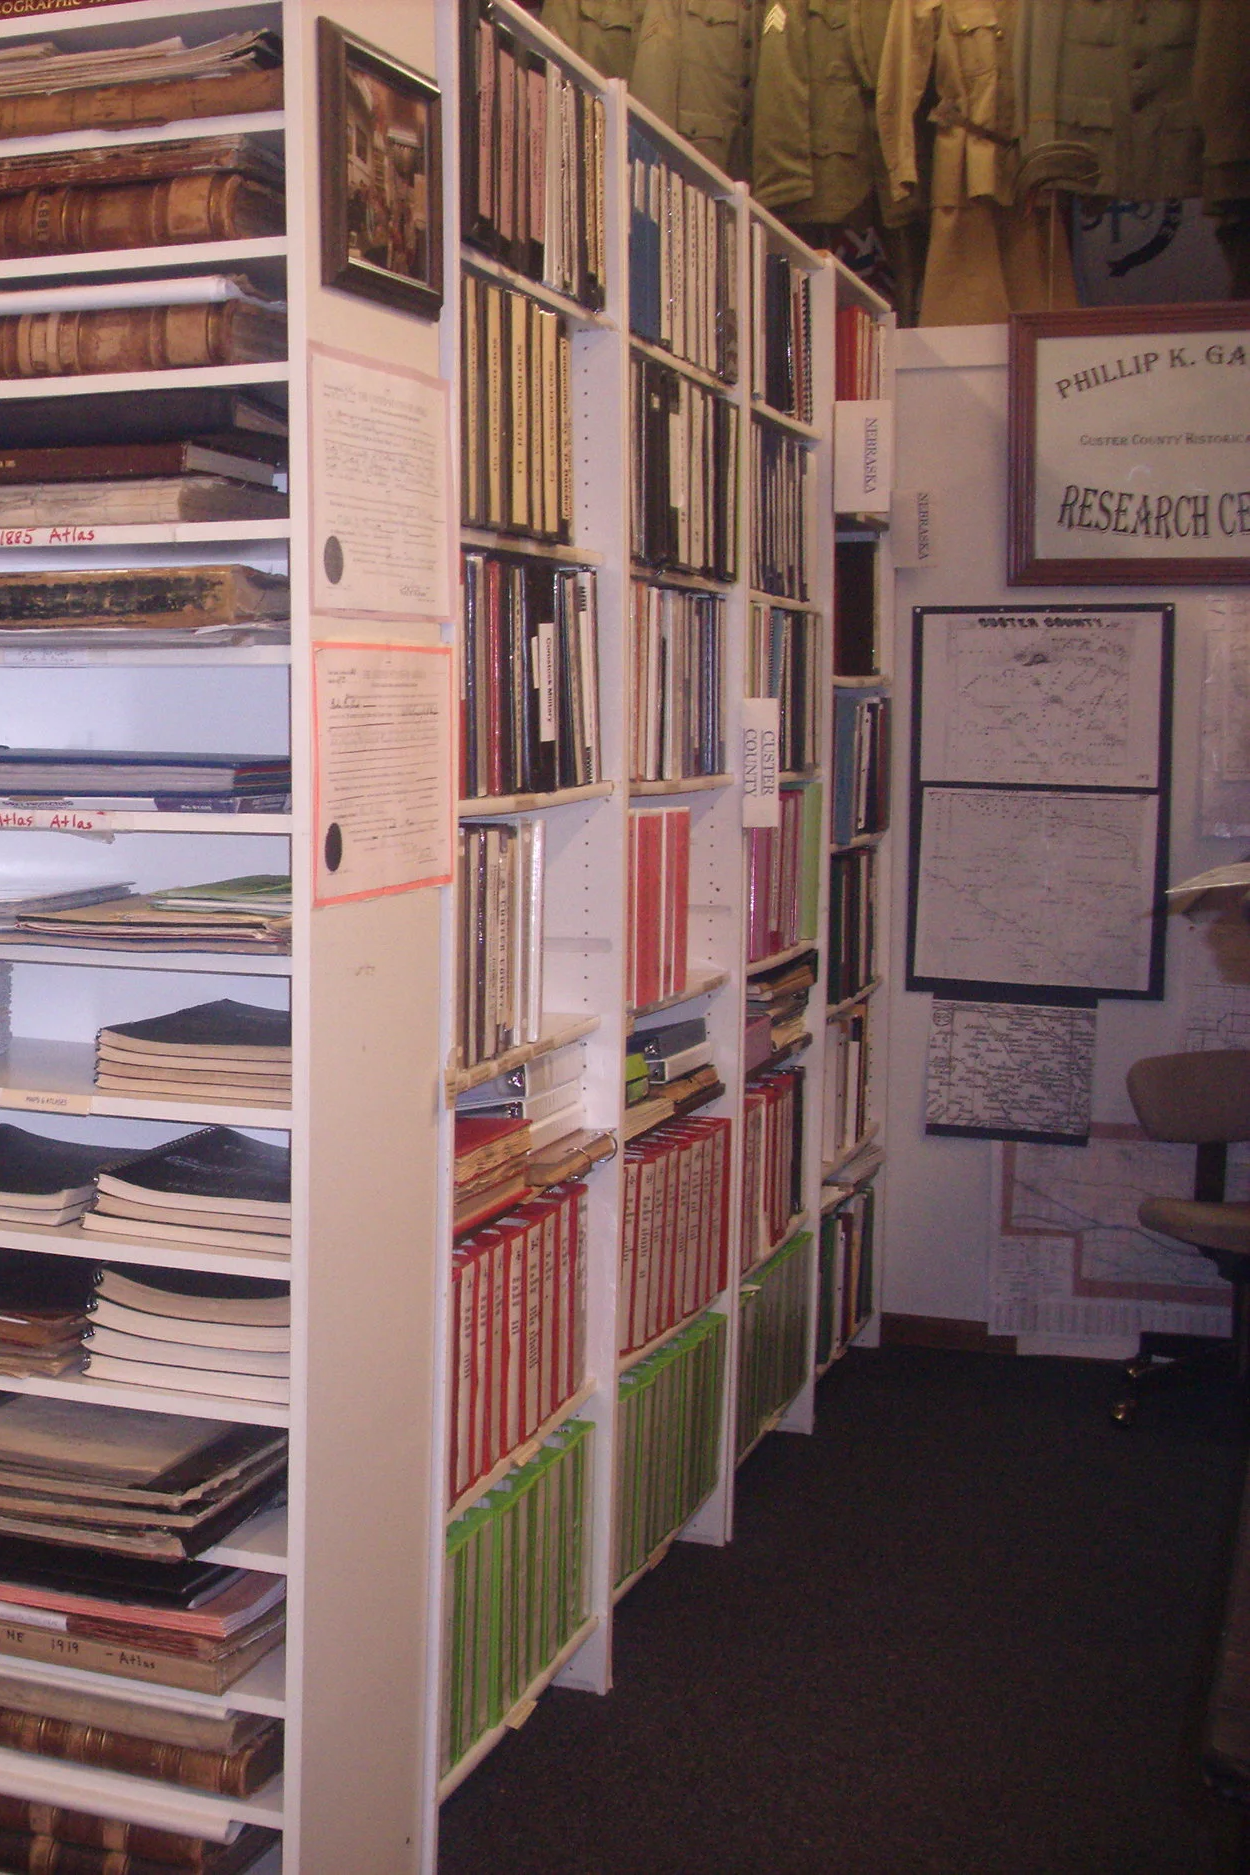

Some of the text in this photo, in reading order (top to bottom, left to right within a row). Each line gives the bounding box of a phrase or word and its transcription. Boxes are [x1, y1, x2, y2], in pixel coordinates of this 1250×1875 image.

[1055, 352, 1159, 399] PHILLIP
[1169, 347, 1196, 369] K.
[864, 417, 879, 495] NEBRASKA
[1080, 434, 1128, 446] CUSTER
[1132, 433, 1184, 446] COUNTY
[0, 526, 95, 546] 1885 Atlas
[918, 492, 931, 561] NEBRASKA
[1057, 484, 1210, 539] RESEARCH
[745, 728, 758, 798] COUNTY
[762, 730, 775, 797] CUSTER
[50, 814, 93, 831] Atlas
[6, 1629, 25, 1643] NE
[51, 1638, 79, 1655] 1919
[119, 1651, 156, 1669] Atlas
